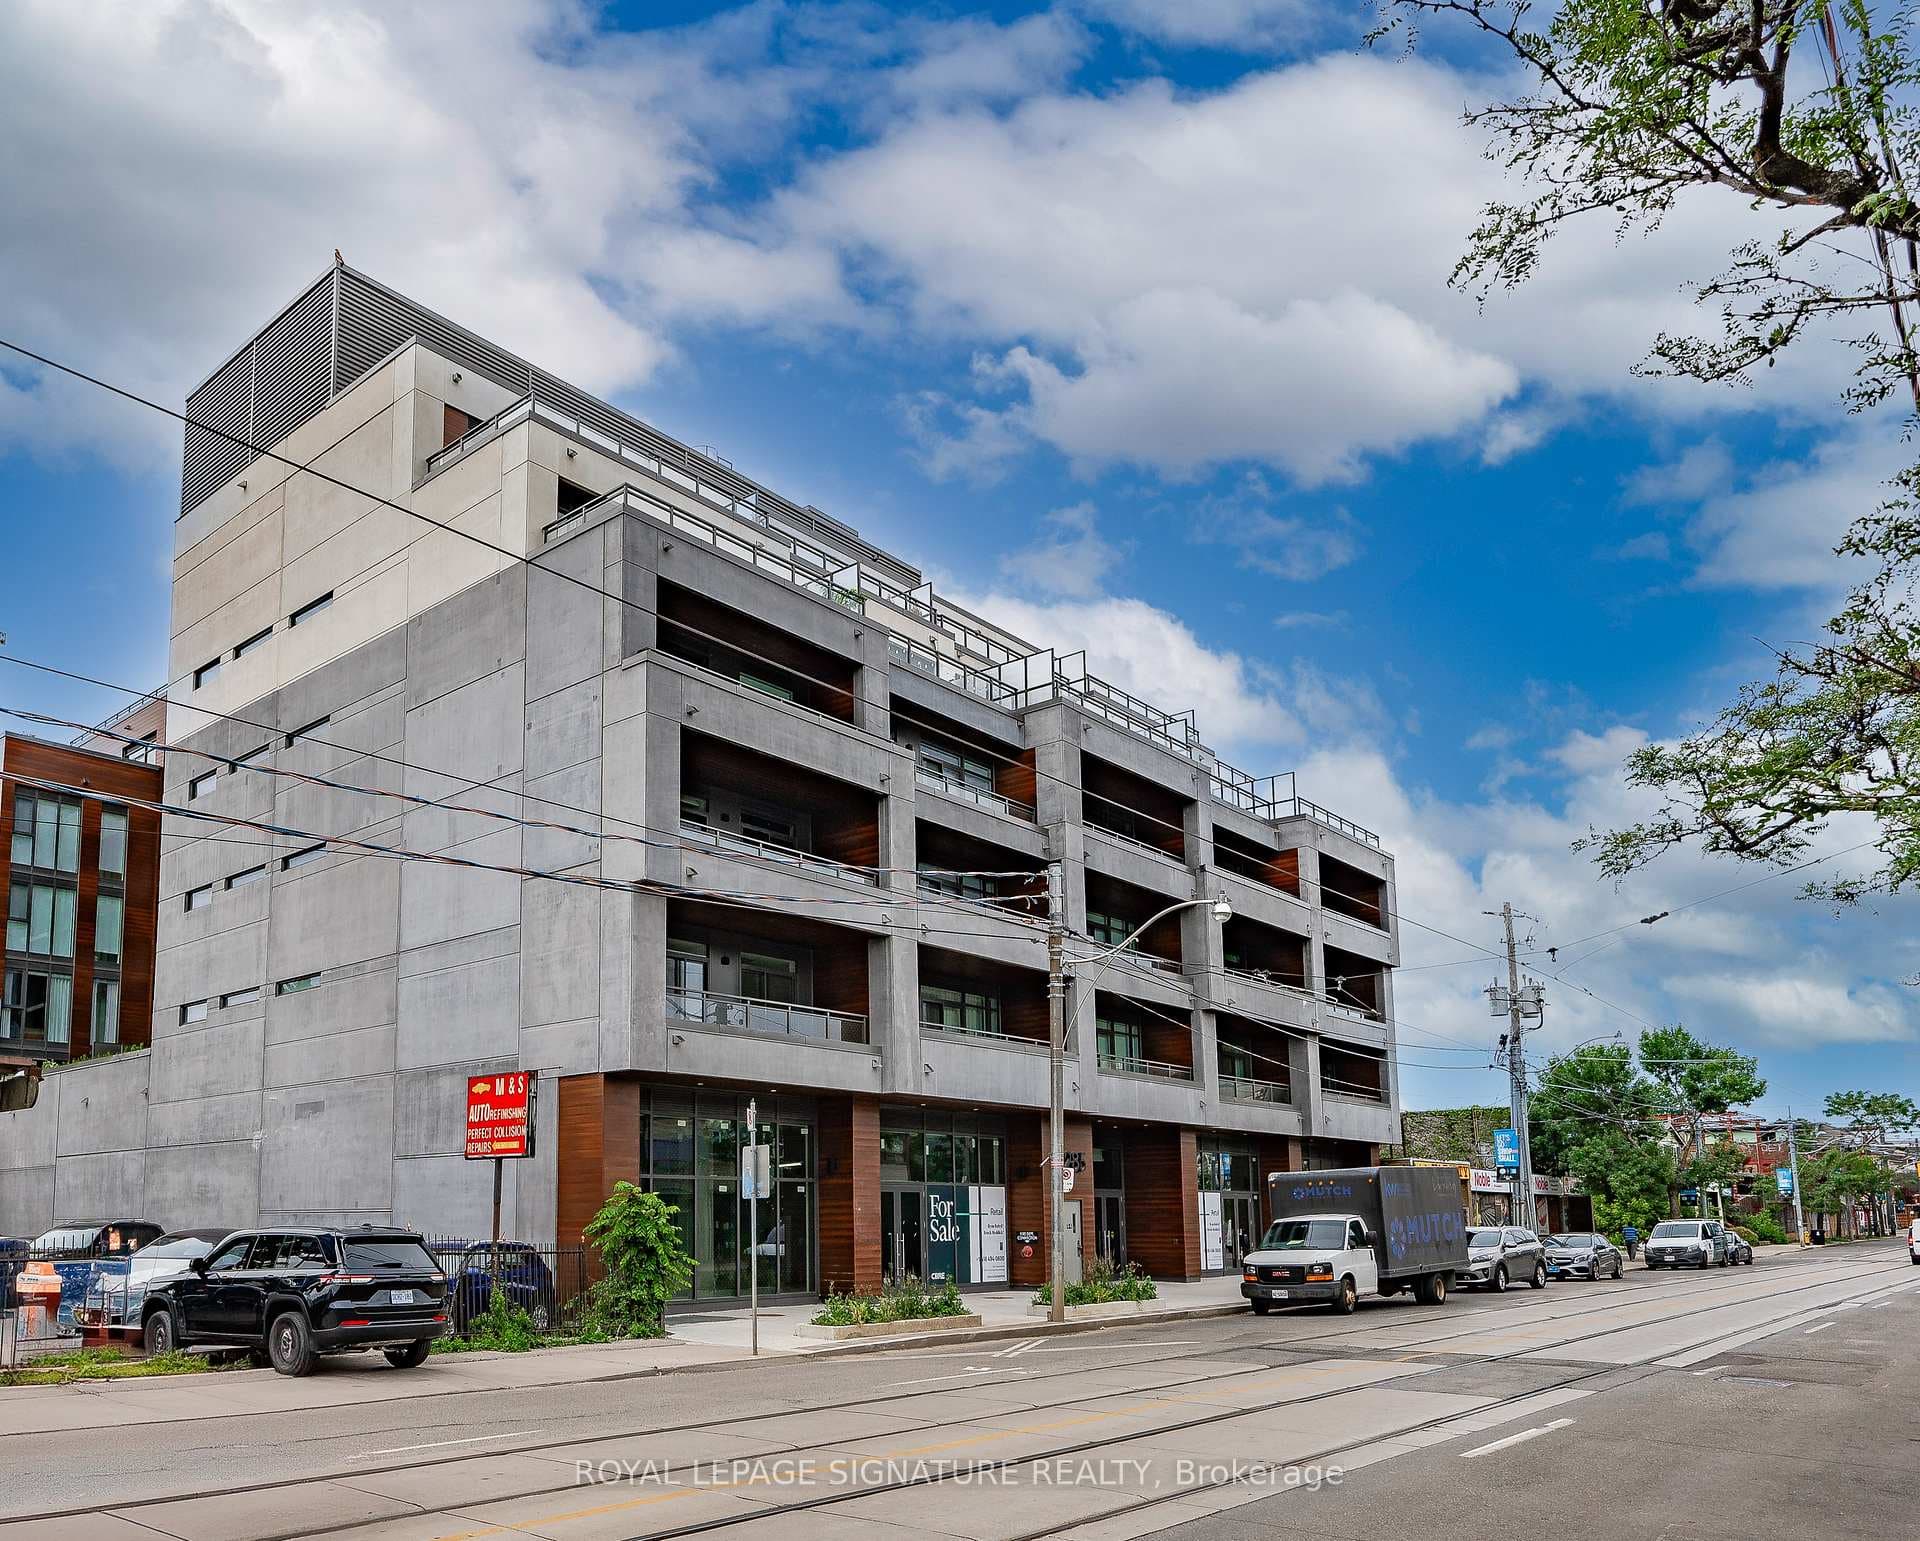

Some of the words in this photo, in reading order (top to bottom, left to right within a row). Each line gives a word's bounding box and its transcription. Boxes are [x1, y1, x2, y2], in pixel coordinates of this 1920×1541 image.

[495, 1077, 505, 1096] M
[508, 1077, 516, 1095] &
[517, 1075, 525, 1094] S
[467, 1127, 492, 1140] PERFECT
[493, 1124, 527, 1139] COLLISION
[467, 1141, 492, 1154] REPAIRS
[1474, 1171, 1491, 1187] Noble
[1305, 1184, 1352, 1197] MUTCH
[929, 1194, 954, 1218] For
[929, 1218, 961, 1242] Sale
[1407, 1210, 1465, 1245] MUTCH
